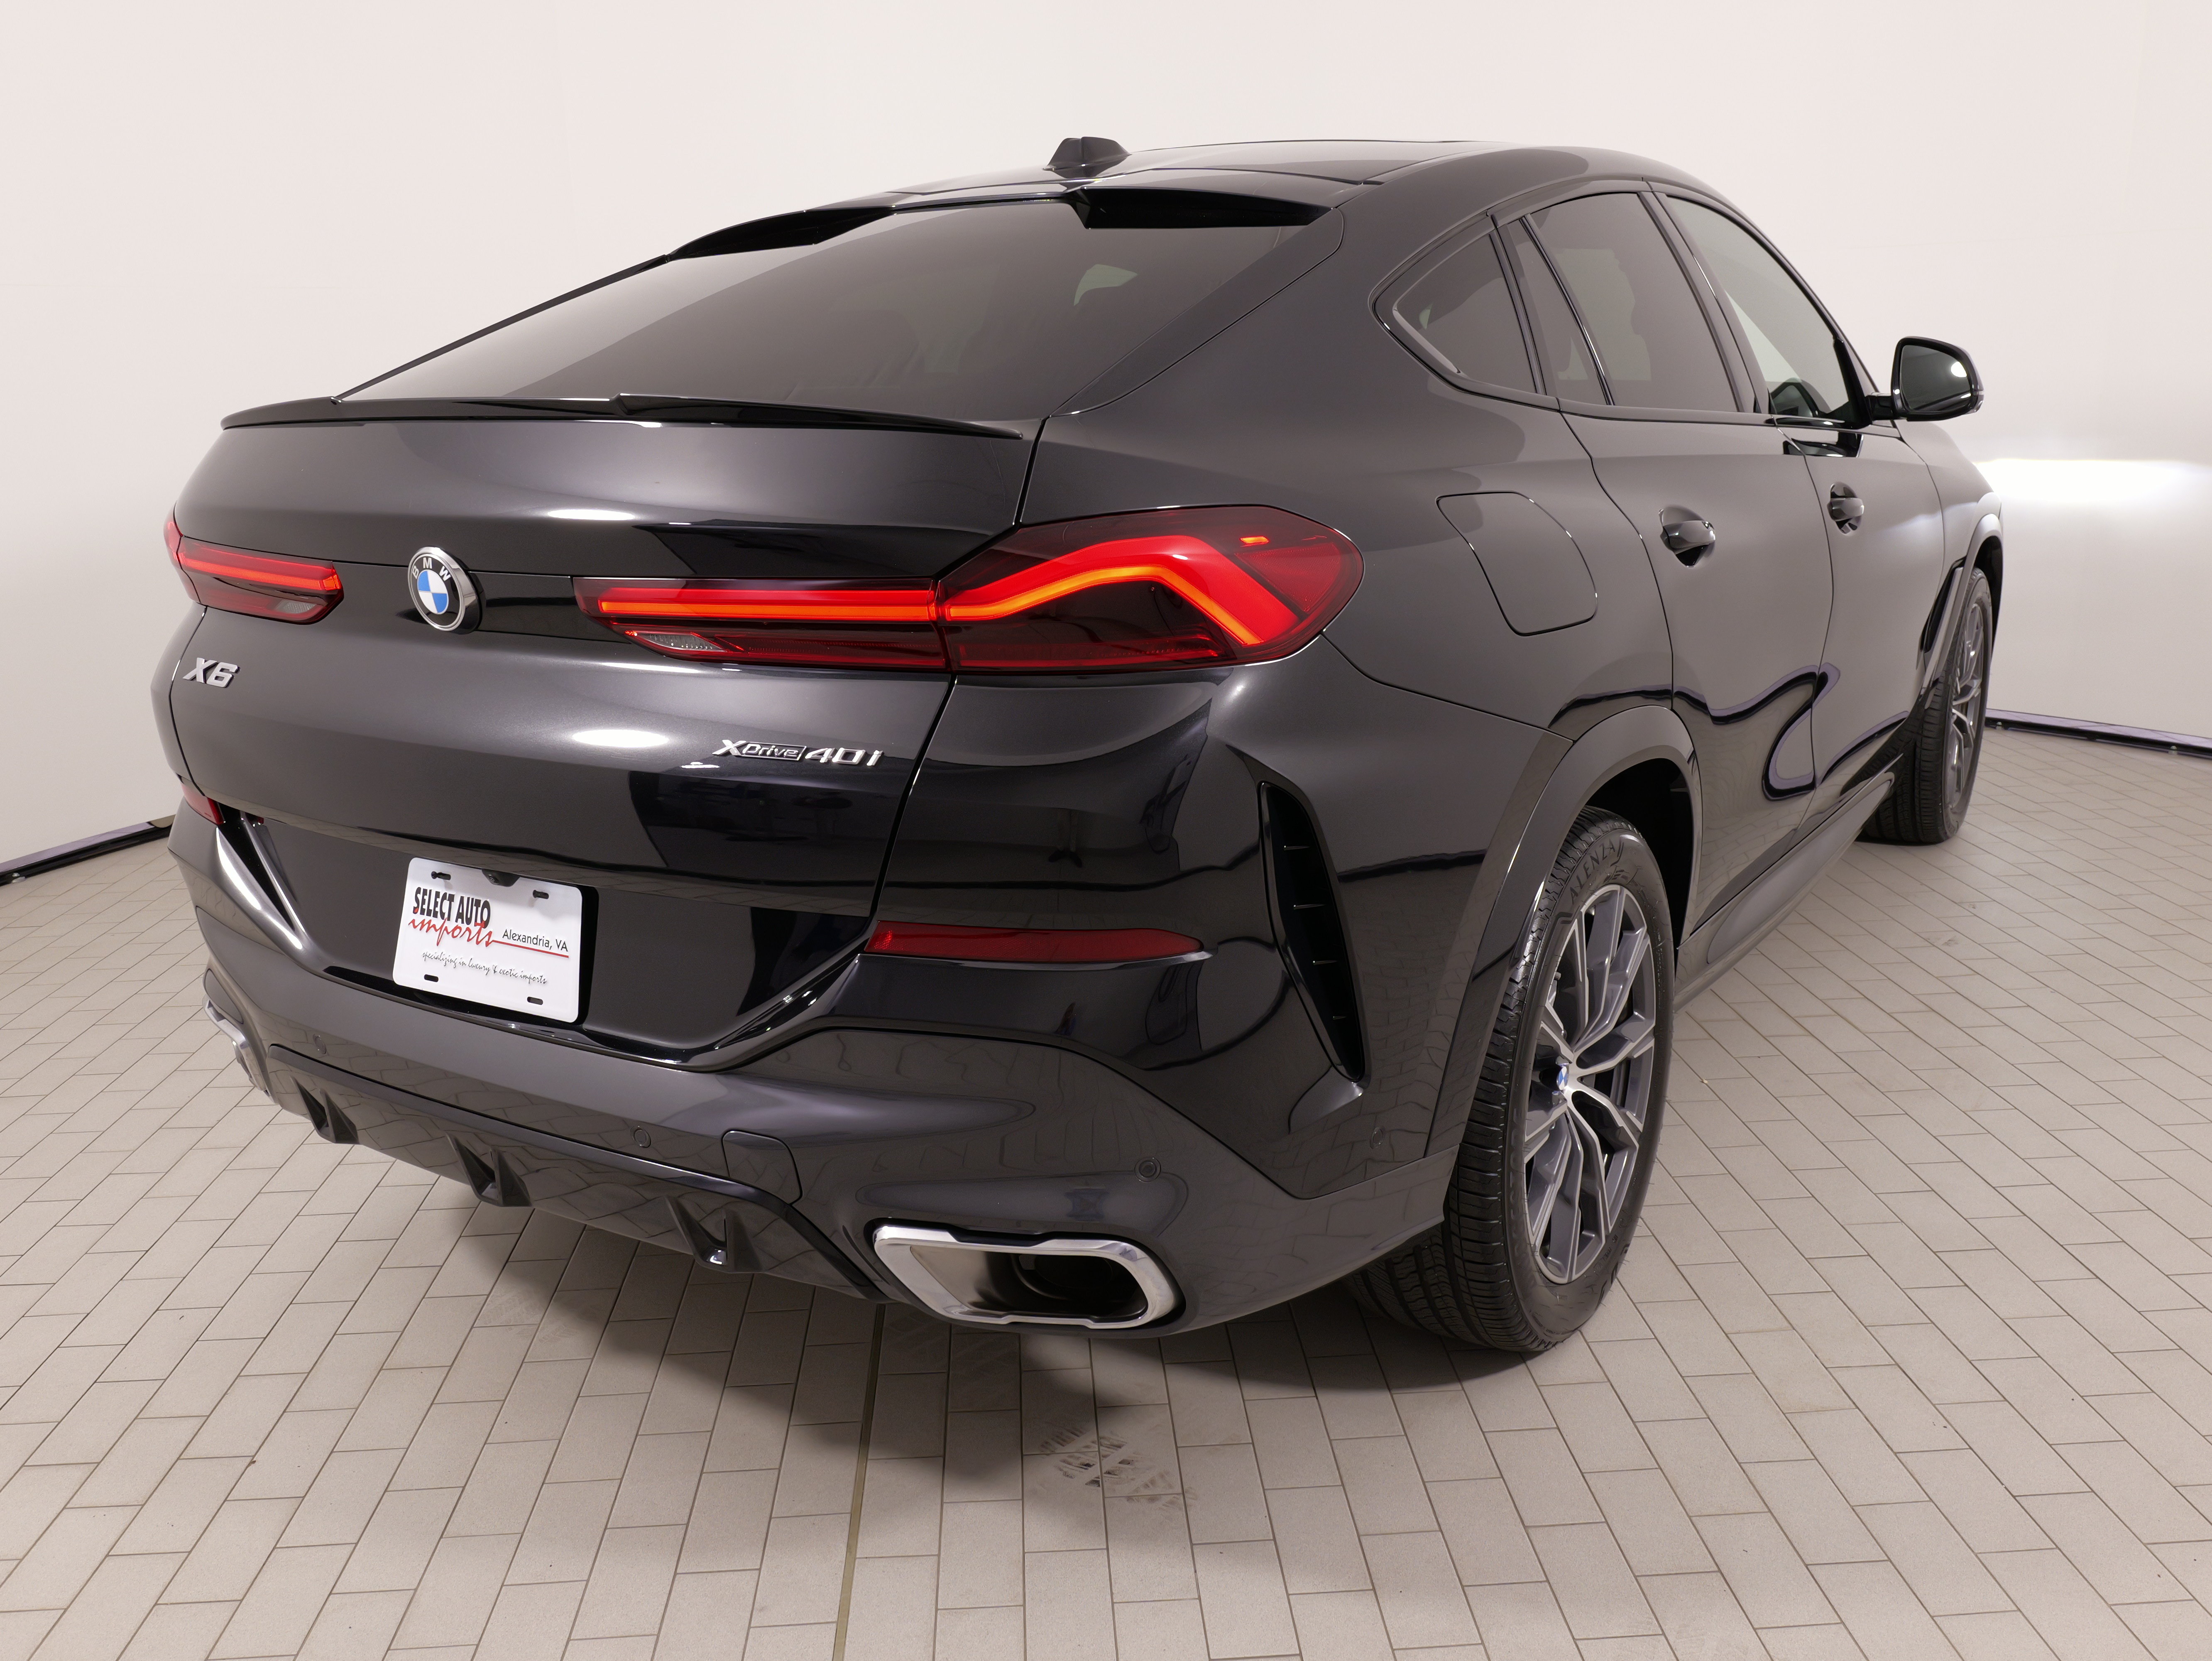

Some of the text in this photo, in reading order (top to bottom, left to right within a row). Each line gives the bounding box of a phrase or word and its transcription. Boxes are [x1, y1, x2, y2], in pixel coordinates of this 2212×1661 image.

[412, 557, 451, 581] BMW
[183, 657, 239, 688] X6
[1570, 838, 1615, 904] ALENZA
[413, 887, 491, 928] SELECT AUTO
[408, 918, 493, 947] imports
[502, 929, 568, 952] Alexandria, VA
[422, 951, 547, 985] specializing in luxury & exotic imports
